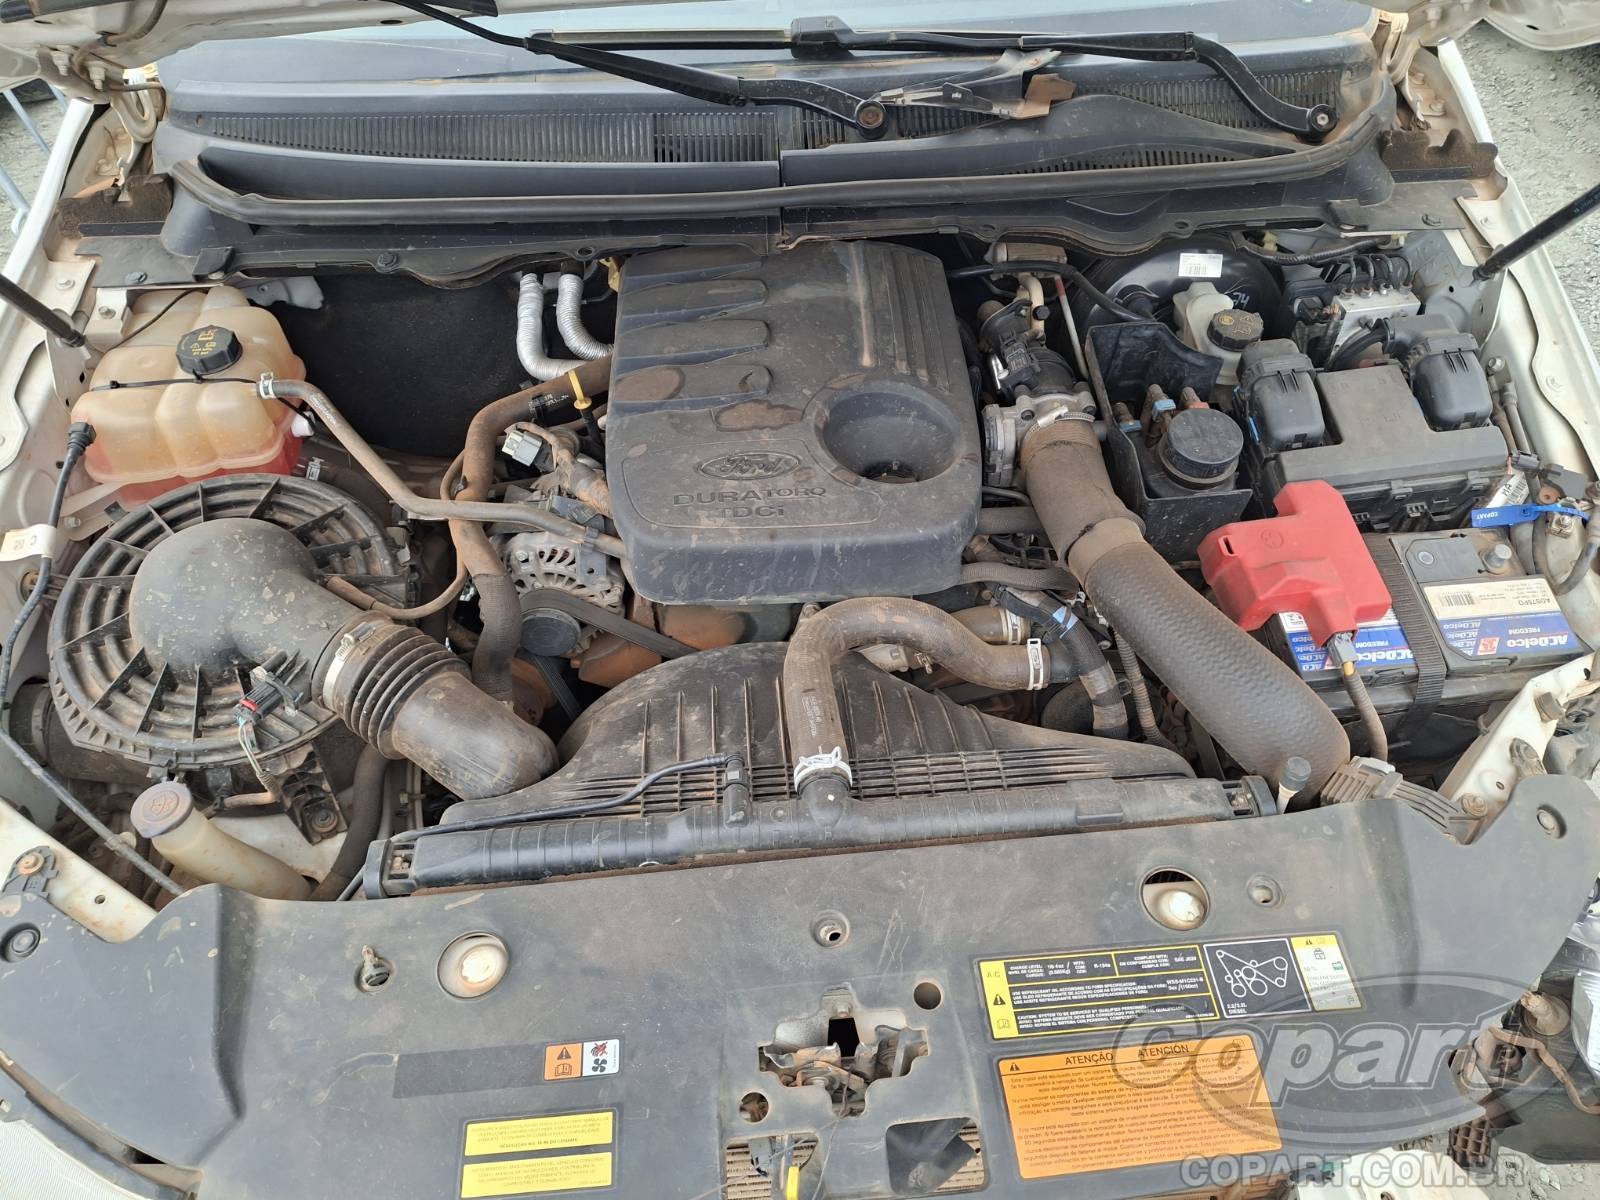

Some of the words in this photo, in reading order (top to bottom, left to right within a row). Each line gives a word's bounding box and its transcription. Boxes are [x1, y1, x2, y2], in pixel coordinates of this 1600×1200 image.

[718, 504, 785, 518] TDCi
[1476, 511, 1499, 520] COPART
[1508, 626, 1541, 636] FREEDOM
[1355, 639, 1389, 649] FREEDOM
[1506, 633, 1569, 649] ACDelco
[1065, 1051, 1114, 1066] ATENÇÃO
[1137, 1044, 1189, 1059] ATENCIÓN
